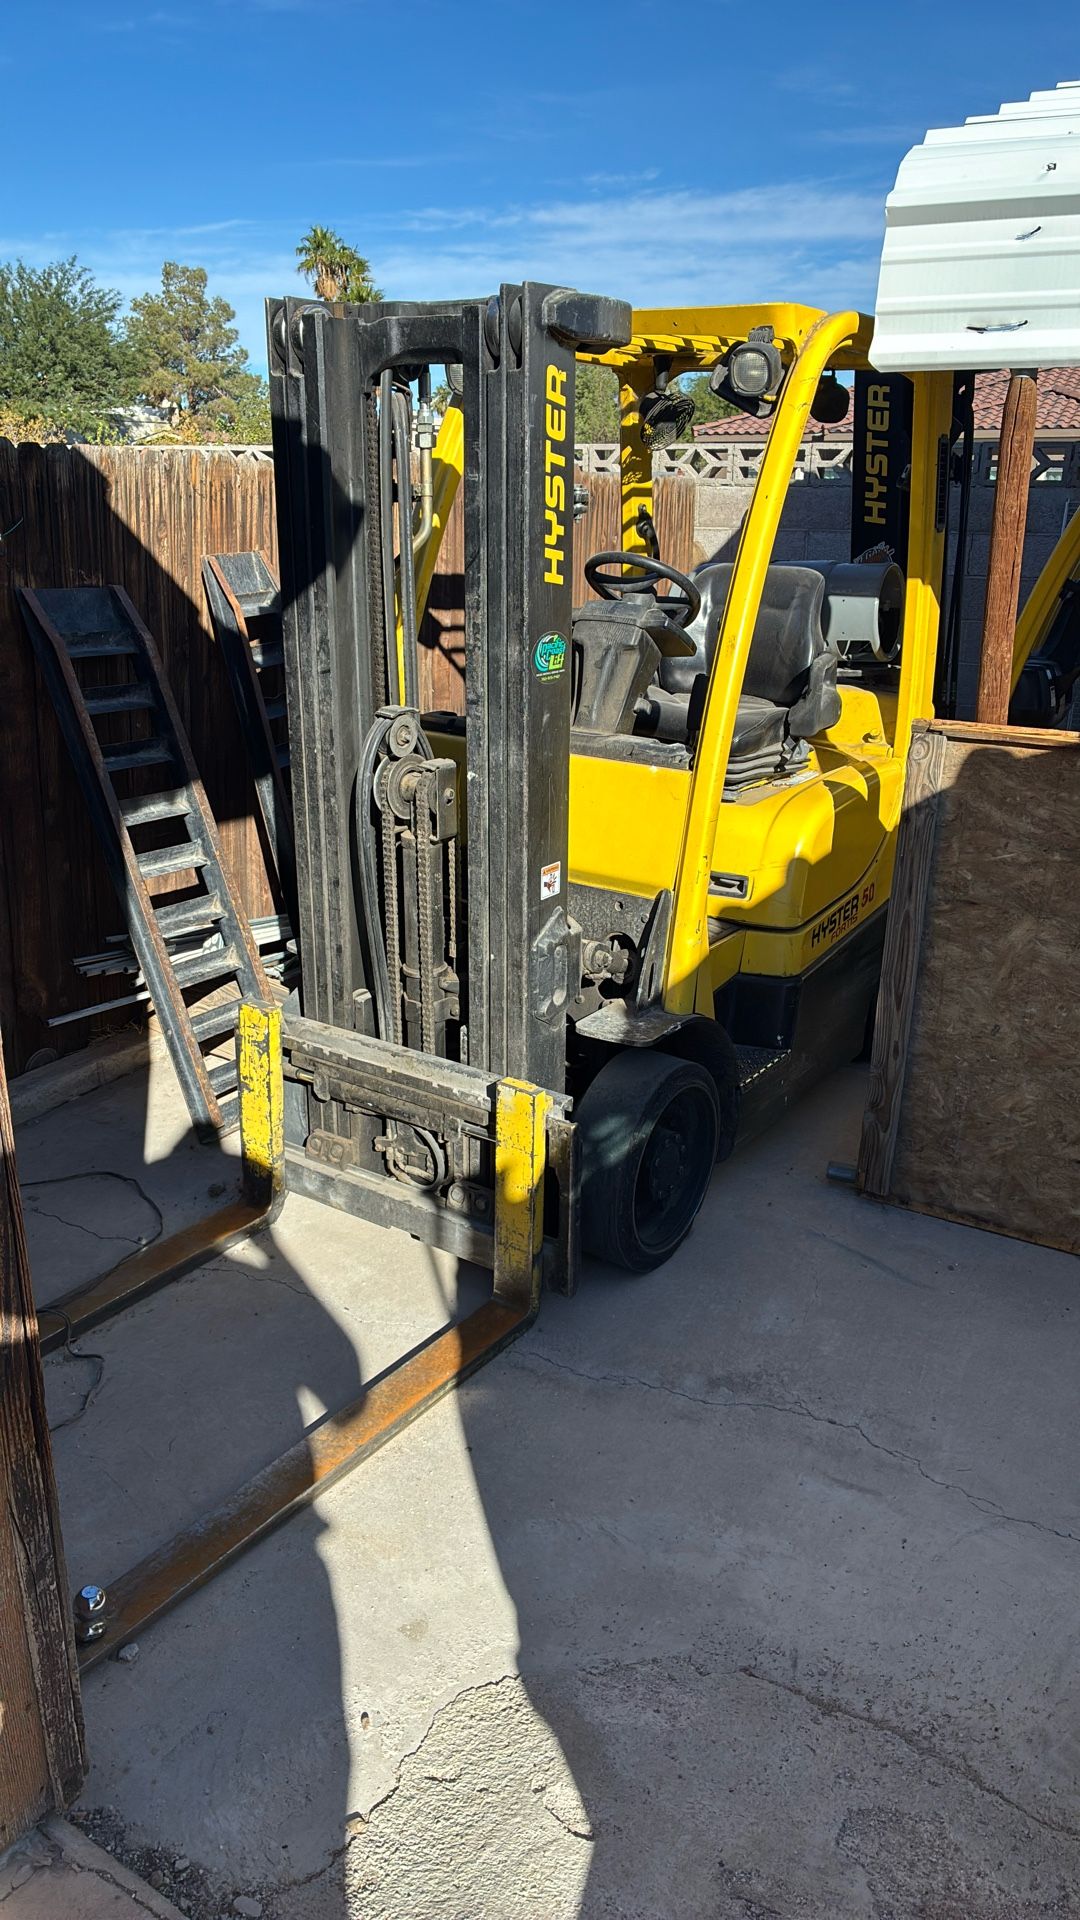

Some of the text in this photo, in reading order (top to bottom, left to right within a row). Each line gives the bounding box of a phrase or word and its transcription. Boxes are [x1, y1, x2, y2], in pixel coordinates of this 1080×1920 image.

[544, 364, 567, 585] HYSTER
[864, 384, 890, 525] HYSTER
[811, 882, 875, 948] HYSTER 50
[831, 914, 858, 943] FORTIS
